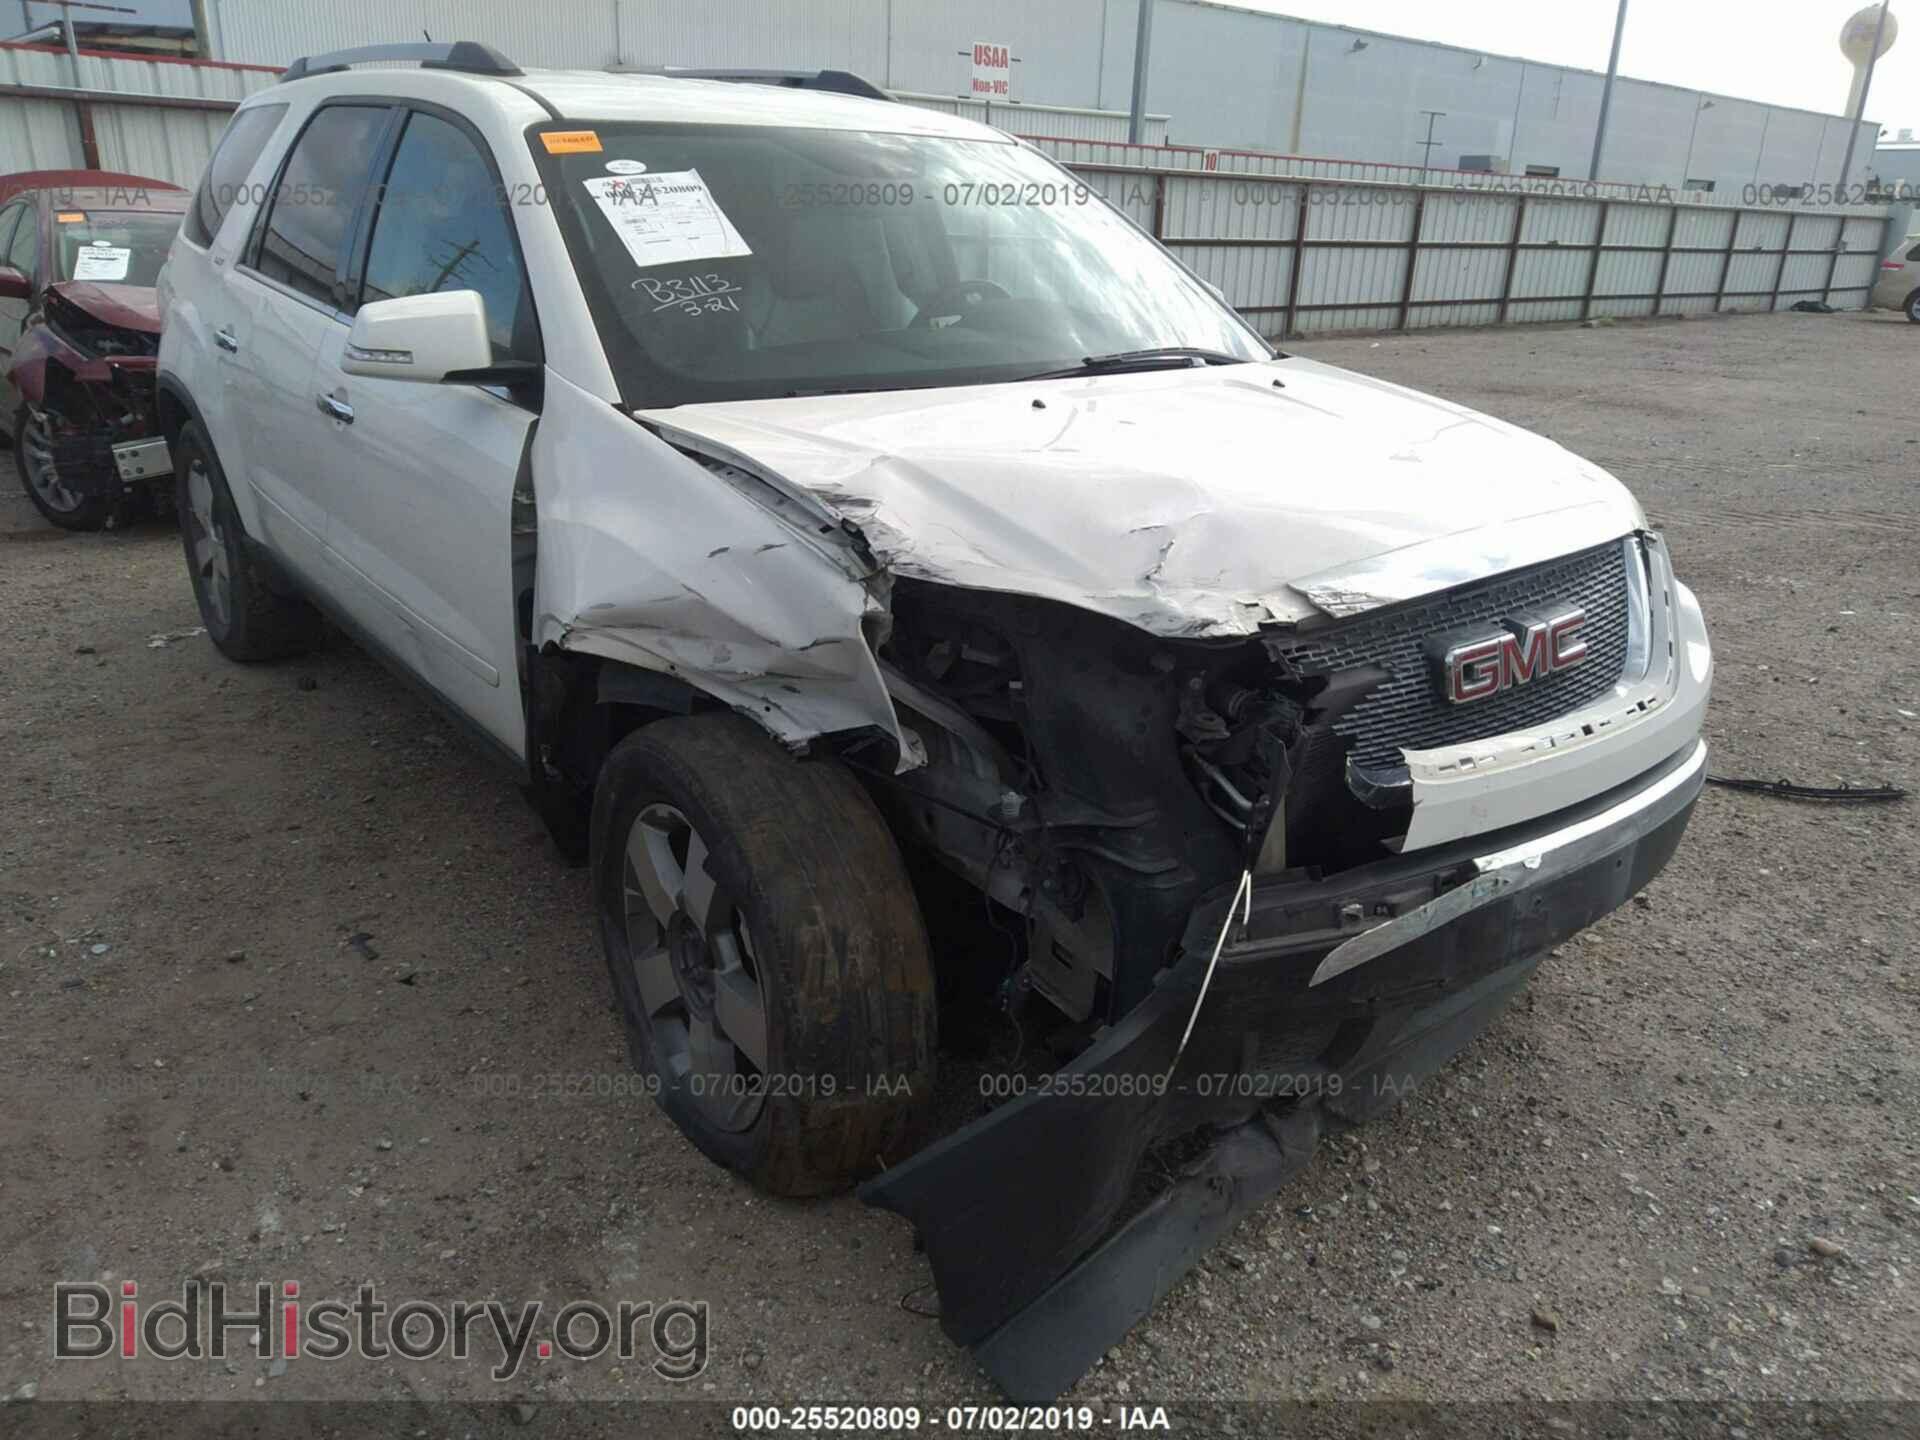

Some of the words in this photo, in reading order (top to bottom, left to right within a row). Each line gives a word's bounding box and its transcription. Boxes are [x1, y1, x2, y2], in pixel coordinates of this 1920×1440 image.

[974, 44, 1008, 68] USAA
[1204, 152, 1216, 171] 10
[1446, 608, 1588, 703] GMC
